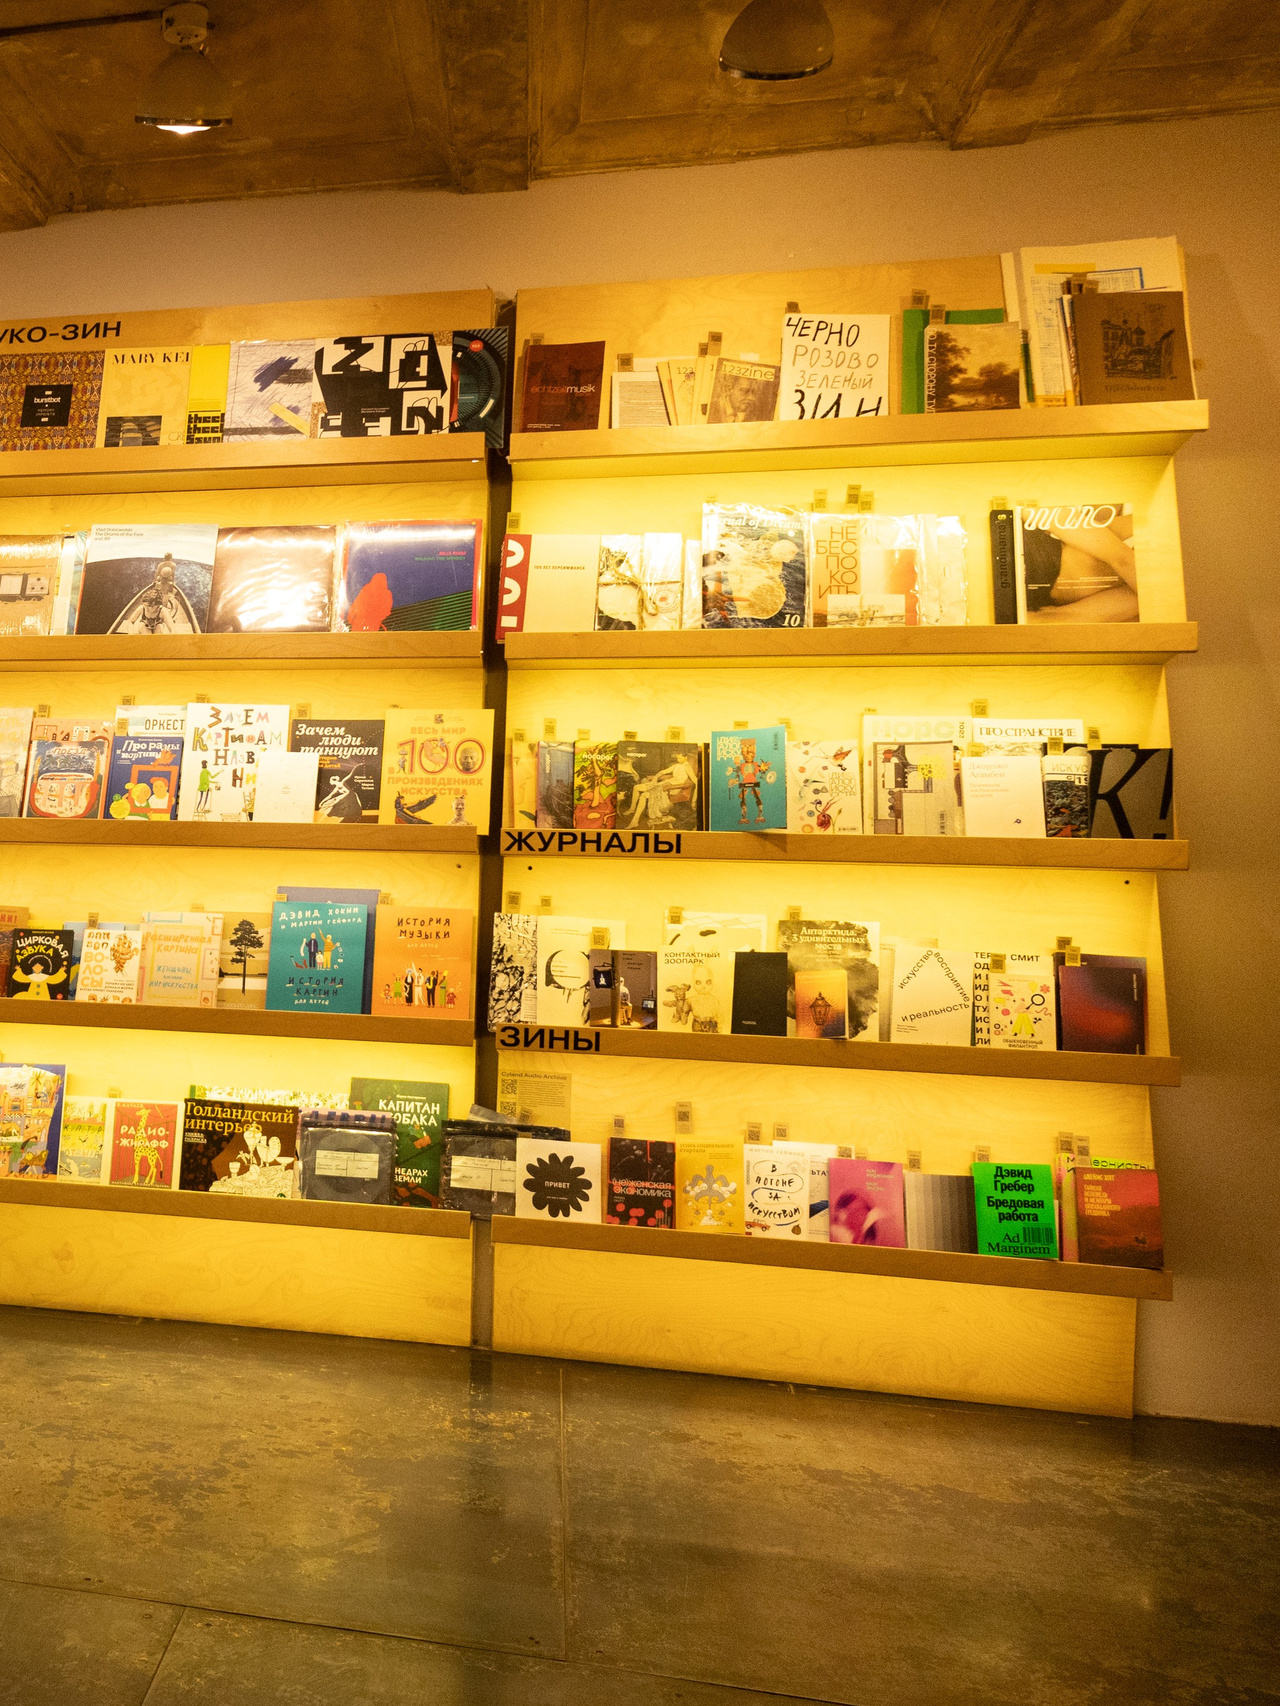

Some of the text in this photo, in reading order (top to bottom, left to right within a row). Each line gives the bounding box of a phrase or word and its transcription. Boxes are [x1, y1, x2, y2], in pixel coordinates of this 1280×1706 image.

[786, 317, 860, 347] ЧЕРНО
[112, 354, 156, 365] MARY
[793, 344, 879, 370] РОЗОВО
[722, 364, 774, 380] 123zine
[796, 370, 873, 390] ЗЕЛЕНЫЙ
[33, 396, 61, 404] burstbot
[830, 526, 857, 540] НЕ
[816, 540, 857, 555] БЕС
[826, 555, 858, 570] ПО
[829, 570, 858, 585] КО
[781, 613, 800, 628] 10
[208, 706, 270, 728] ЗАЧЕМ
[145, 719, 186, 731] ОРКЕСТ
[296, 723, 346, 736] Зачем
[410, 726, 466, 735] ВЕСЬ МИР
[122, 739, 147, 752] Про
[192, 727, 282, 752] КАРТИНАМ
[318, 735, 363, 747] люди
[51, 747, 88, 756] ПОЕЗД
[213, 749, 257, 766] НАЗВ
[300, 745, 378, 758] танцуют
[398, 737, 486, 775] 100
[582, 752, 615, 762] носорог
[387, 777, 483, 787] ПРОИЗВЕДЕНИЯХ
[400, 786, 468, 796] ИСКУССТВА
[504, 831, 682, 854] ЖУРНАЛЫ
[279, 906, 359, 921] ДЭВИД ХОКНИ
[291, 918, 323, 928] МАРТИН
[327, 916, 363, 925] ГЕЙФОРД
[397, 917, 451, 927] ИСТОРИЯ
[399, 929, 451, 940] МУЗЫКИ
[799, 927, 858, 938] Антарктида.
[792, 933, 866, 945] 3 удивительных
[16, 935, 69, 960] ЦИРКОВАЯ
[16, 945, 54, 963] АЗБУКА
[83, 951, 109, 963] ВО-
[664, 951, 721, 959] КОНТАКТНЫЙ
[1010, 953, 1040, 962] СМИТ
[82, 964, 109, 976] ЛО-
[898, 949, 934, 989] искусство
[81, 977, 103, 988] СЫ
[288, 976, 345, 987] ИСТОРИЯ
[933, 951, 971, 1003] восприятие
[296, 987, 339, 997] КАРТИН
[910, 1001, 971, 1023] реальность
[499, 1026, 600, 1051] ЗИНЫ
[1002, 1037, 1043, 1045] ОБЫКНОВЕННЫЙ
[501, 1071, 567, 1081] Cyland Audio Archive
[185, 1101, 294, 1124] Голландский
[378, 1099, 440, 1115] КАПИТАН
[120, 1125, 170, 1136] РАДИО-
[184, 1119, 263, 1136] интерьер
[115, 1139, 169, 1148] -ЖИРАФФ
[394, 1167, 428, 1177] НЕДРАХ
[771, 1164, 778, 1173] В
[993, 1165, 1033, 1180] Дэвид
[394, 1174, 423, 1184] ЗЕМЛИ
[544, 1180, 571, 1189] ПРИВЕТ
[612, 1177, 672, 1189] (не)женская
[755, 1176, 795, 1188] ПОГОНЕ
[613, 1186, 672, 1198] экономика
[993, 1179, 1035, 1194] Гребер
[768, 1192, 781, 1202] ЗА
[986, 1196, 1045, 1212] Бредовая
[748, 1202, 802, 1220] ИСКУССТВОМ
[998, 1211, 1039, 1223] работа
[1002, 1232, 1020, 1244] Ad
[987, 1242, 1052, 1256] Marginem
